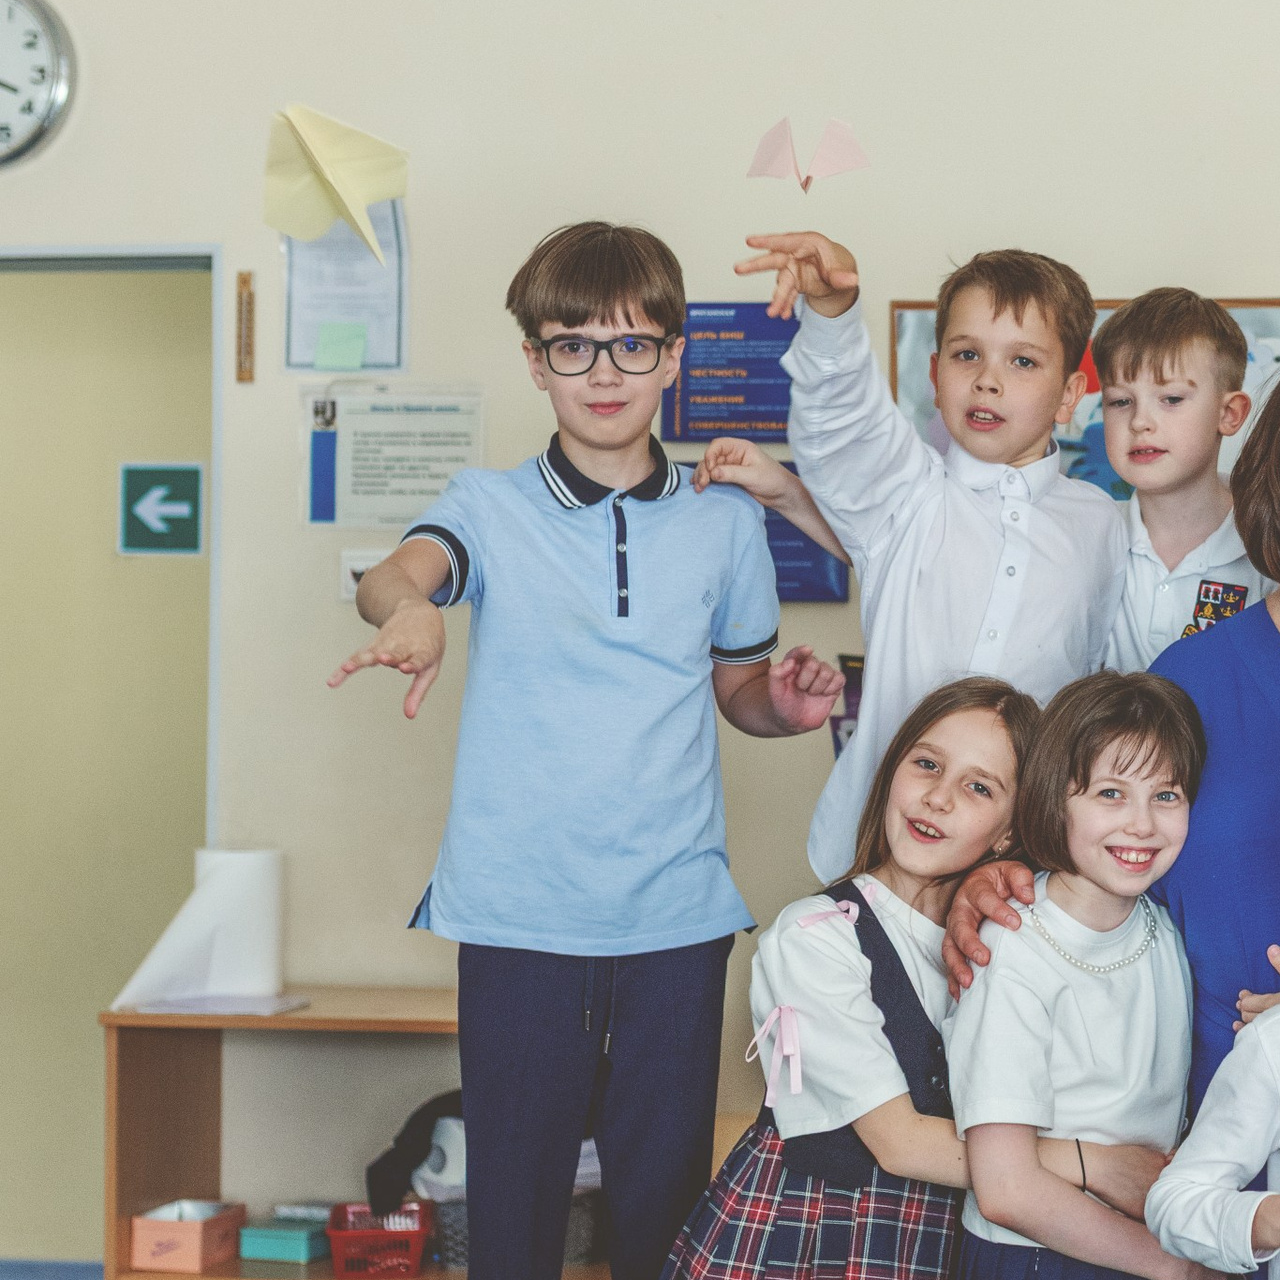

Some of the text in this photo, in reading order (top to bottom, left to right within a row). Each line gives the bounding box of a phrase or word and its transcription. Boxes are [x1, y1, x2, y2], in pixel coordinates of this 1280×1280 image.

[22, 28, 38, 50] 2
[29, 64, 46, 85] 3
[19, 99, 34, 115] 4
